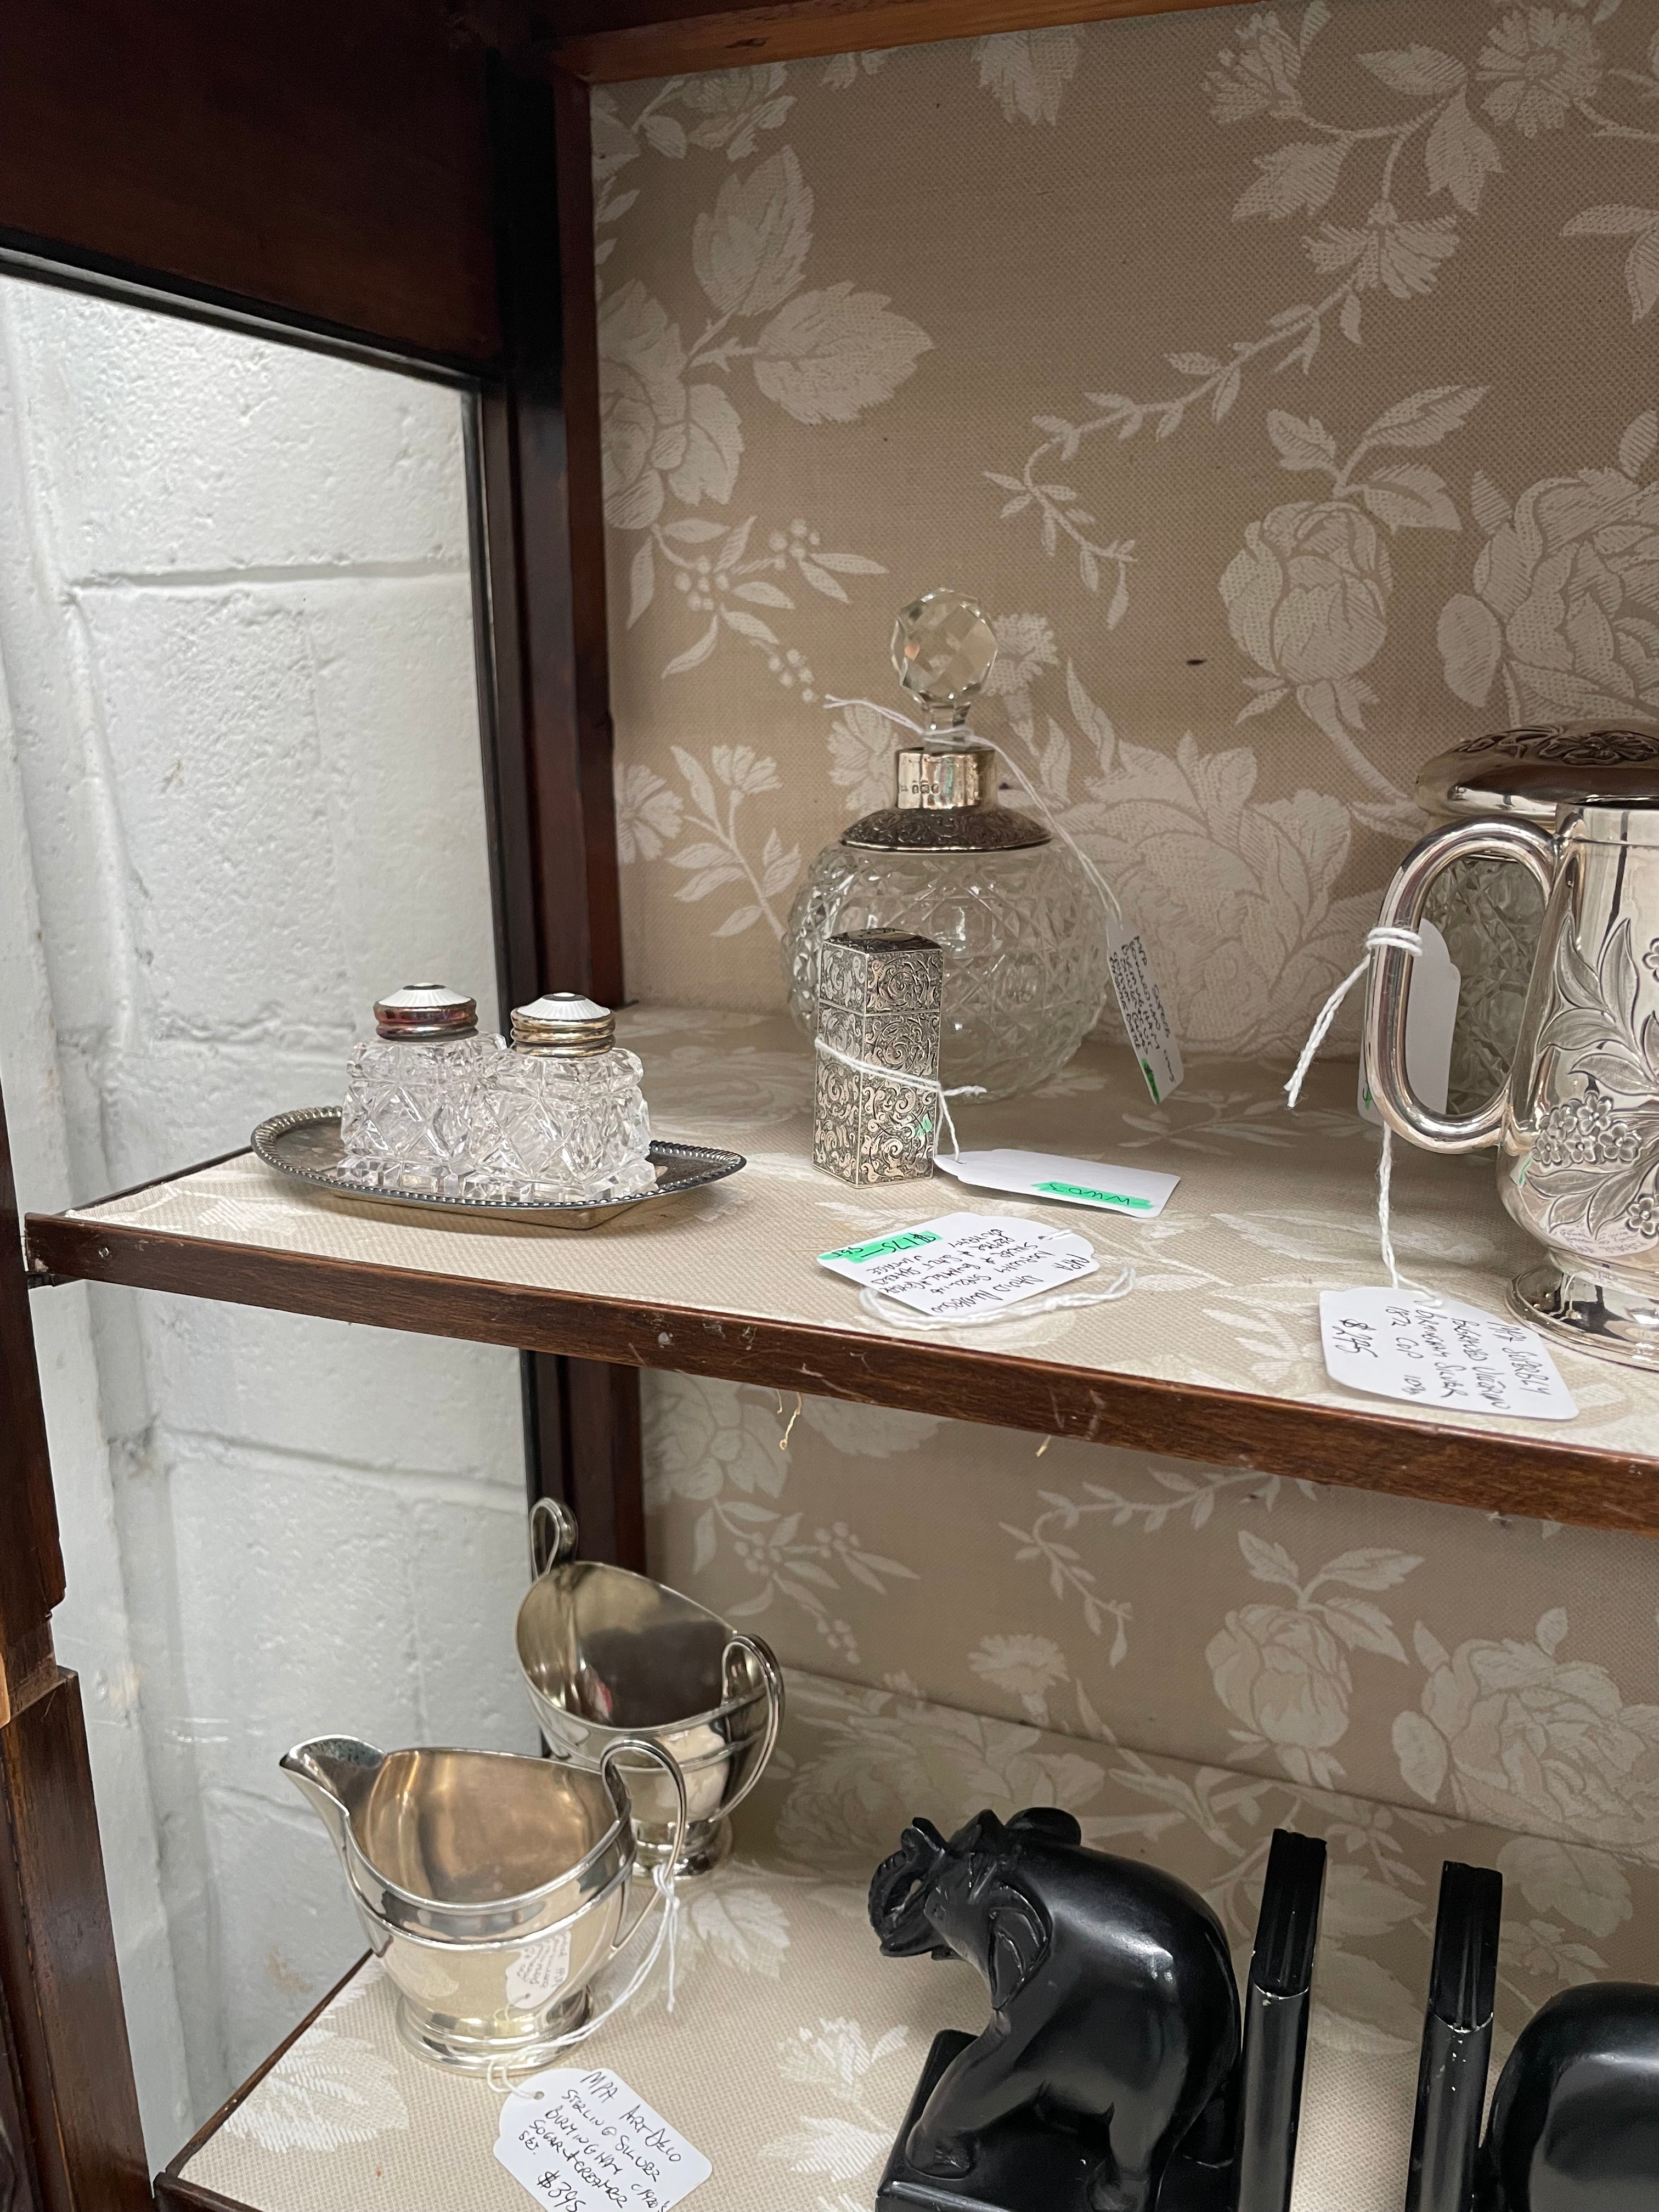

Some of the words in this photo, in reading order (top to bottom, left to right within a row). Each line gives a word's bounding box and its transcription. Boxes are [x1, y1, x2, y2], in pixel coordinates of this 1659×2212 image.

[989, 1241, 1039, 1258] SILVER
[991, 1250, 1056, 1273] NORWAY
[991, 1274, 1045, 1292] DAVID
[1384, 1305, 1412, 1327] 1872
[1433, 1361, 1469, 1398] SILVER
[1500, 1347, 1551, 1395] SUPERBLY
[579, 2070, 618, 2103] MPA
[644, 2127, 681, 2162] DECO
[544, 2104, 623, 2175] BIRMINGHAM
[561, 2089, 617, 2136] STERLING
[614, 2134, 660, 2182] SILVER
